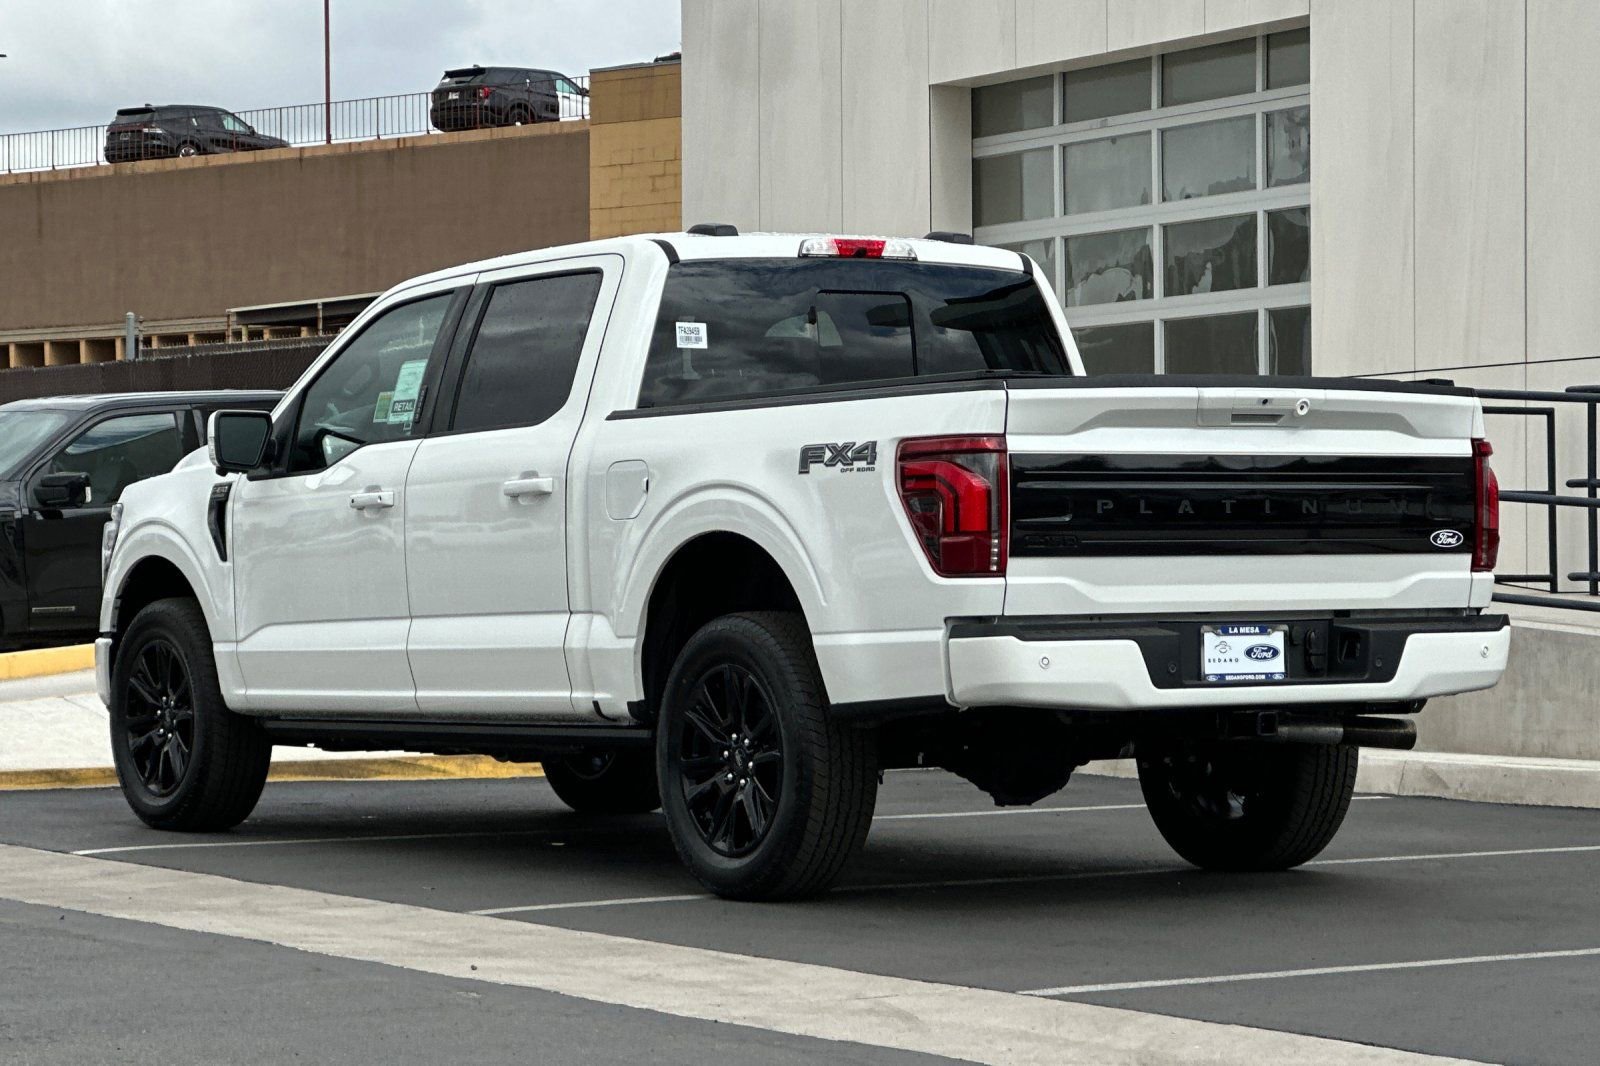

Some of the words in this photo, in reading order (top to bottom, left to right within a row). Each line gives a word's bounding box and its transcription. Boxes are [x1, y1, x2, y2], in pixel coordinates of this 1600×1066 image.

[798, 440, 877, 475] FX4
[1096, 499, 1408, 514] PLATINUM
[1435, 532, 1460, 545] Ford
[1239, 626, 1260, 634] MESA
[1249, 646, 1275, 659] Ford
